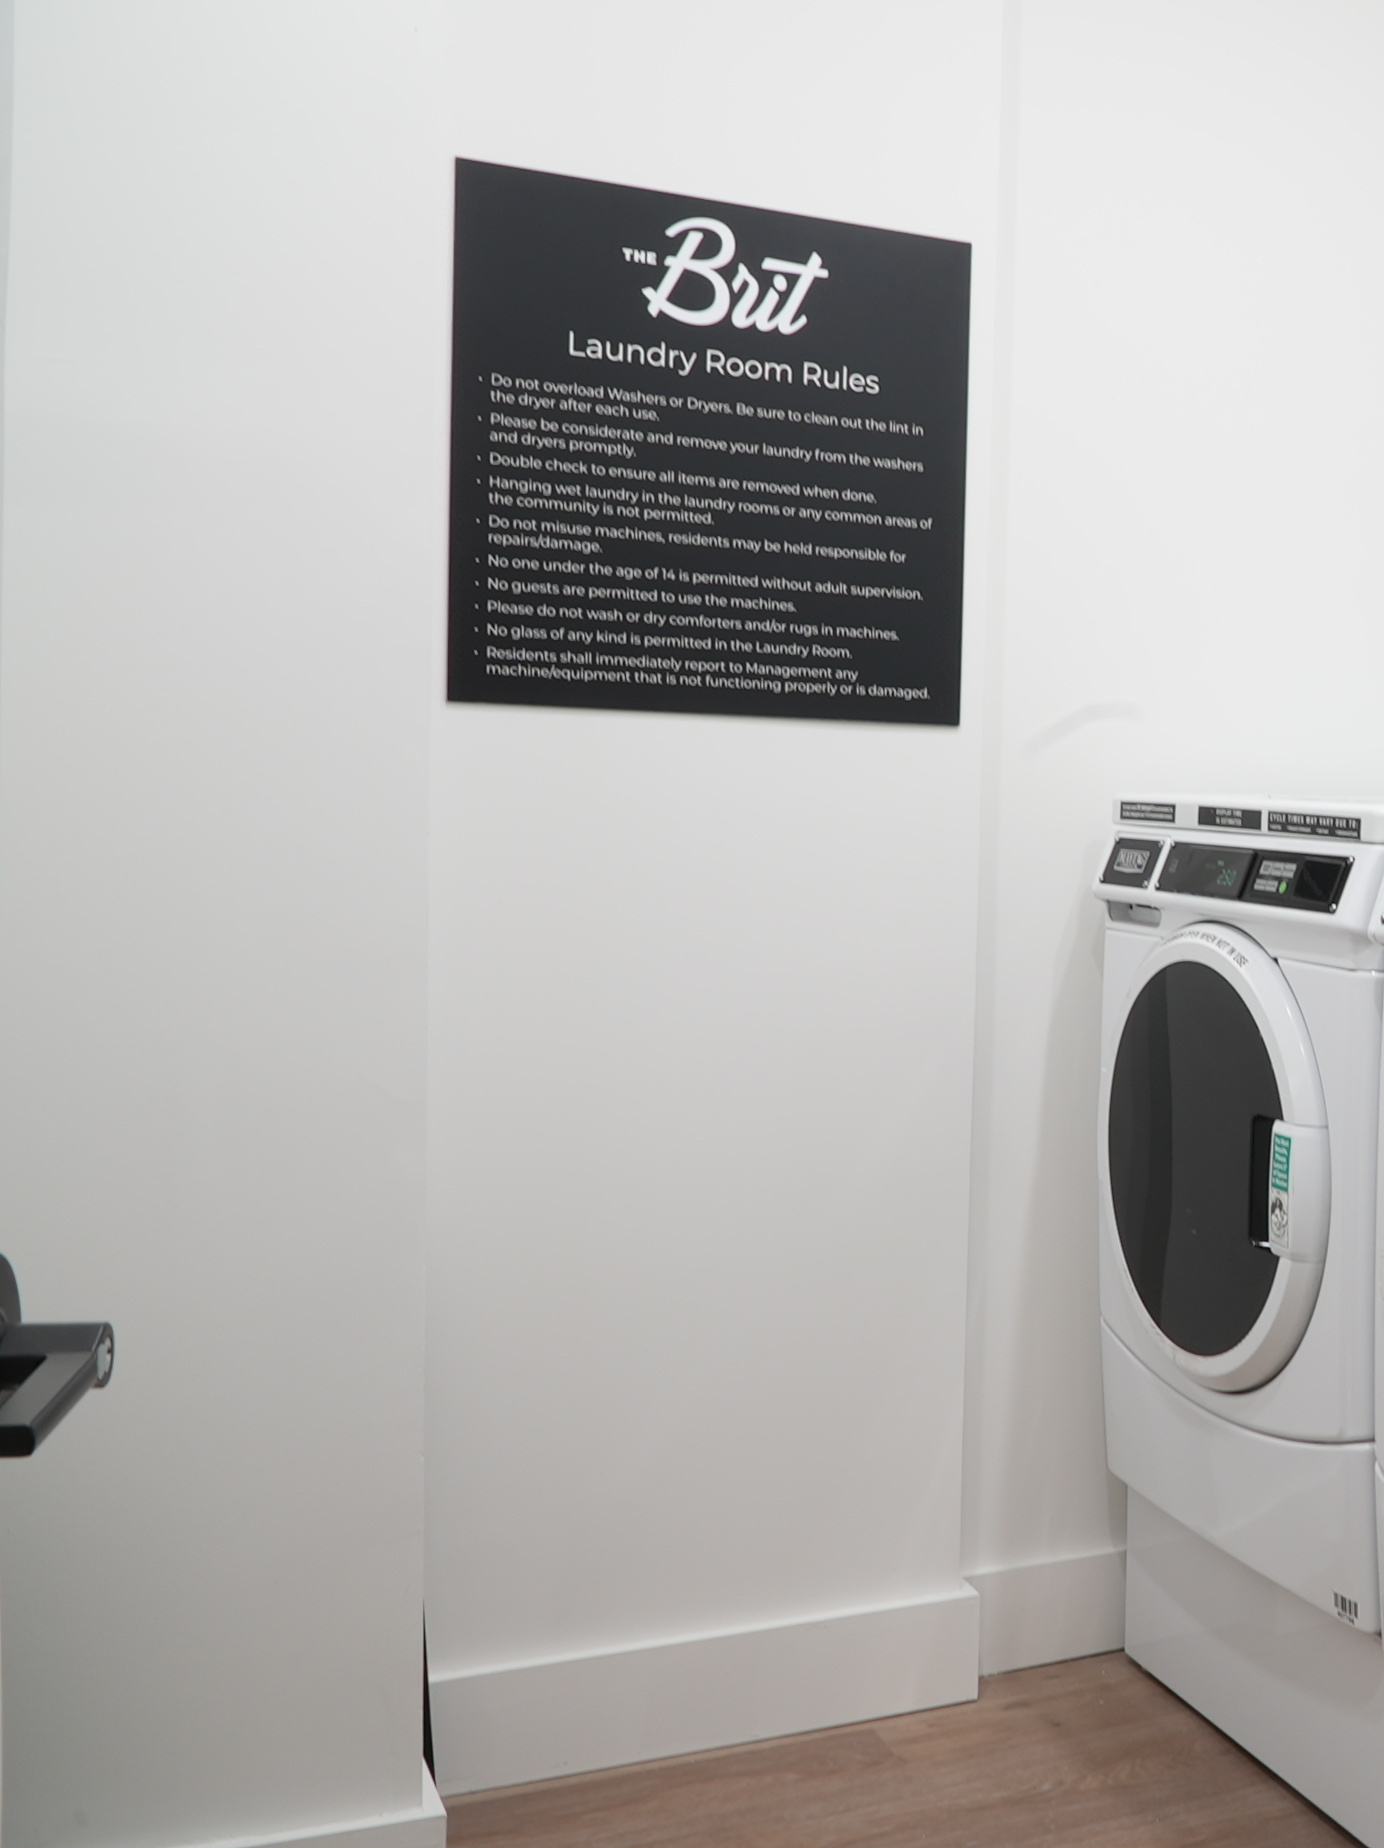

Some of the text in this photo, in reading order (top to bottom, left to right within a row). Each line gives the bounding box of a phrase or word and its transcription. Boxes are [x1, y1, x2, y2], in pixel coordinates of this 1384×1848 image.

[622, 216, 829, 336] THE Brit
[568, 330, 880, 395] Laundry Room Rules
[490, 372, 924, 436] Do not overload Washers or Dryers. Be sure to clean out the lint in
[489, 411, 924, 473] Please be considerate and remove your laundry from the washers
[488, 474, 933, 530] Hanging wet laundry in the laundry rooms or any common areas of
[489, 451, 877, 504] Double check to ensure all items are removed when done.
[488, 491, 714, 525] the community is not permitted.
[487, 532, 602, 554] repairs/damage.
[488, 514, 906, 563] Do not misuse machines, residents may be held responsible for
[486, 645, 858, 682] Residents shall immediately report to Management any
[486, 663, 930, 701] machine/equipment that is not functioning properly or is damaged.
